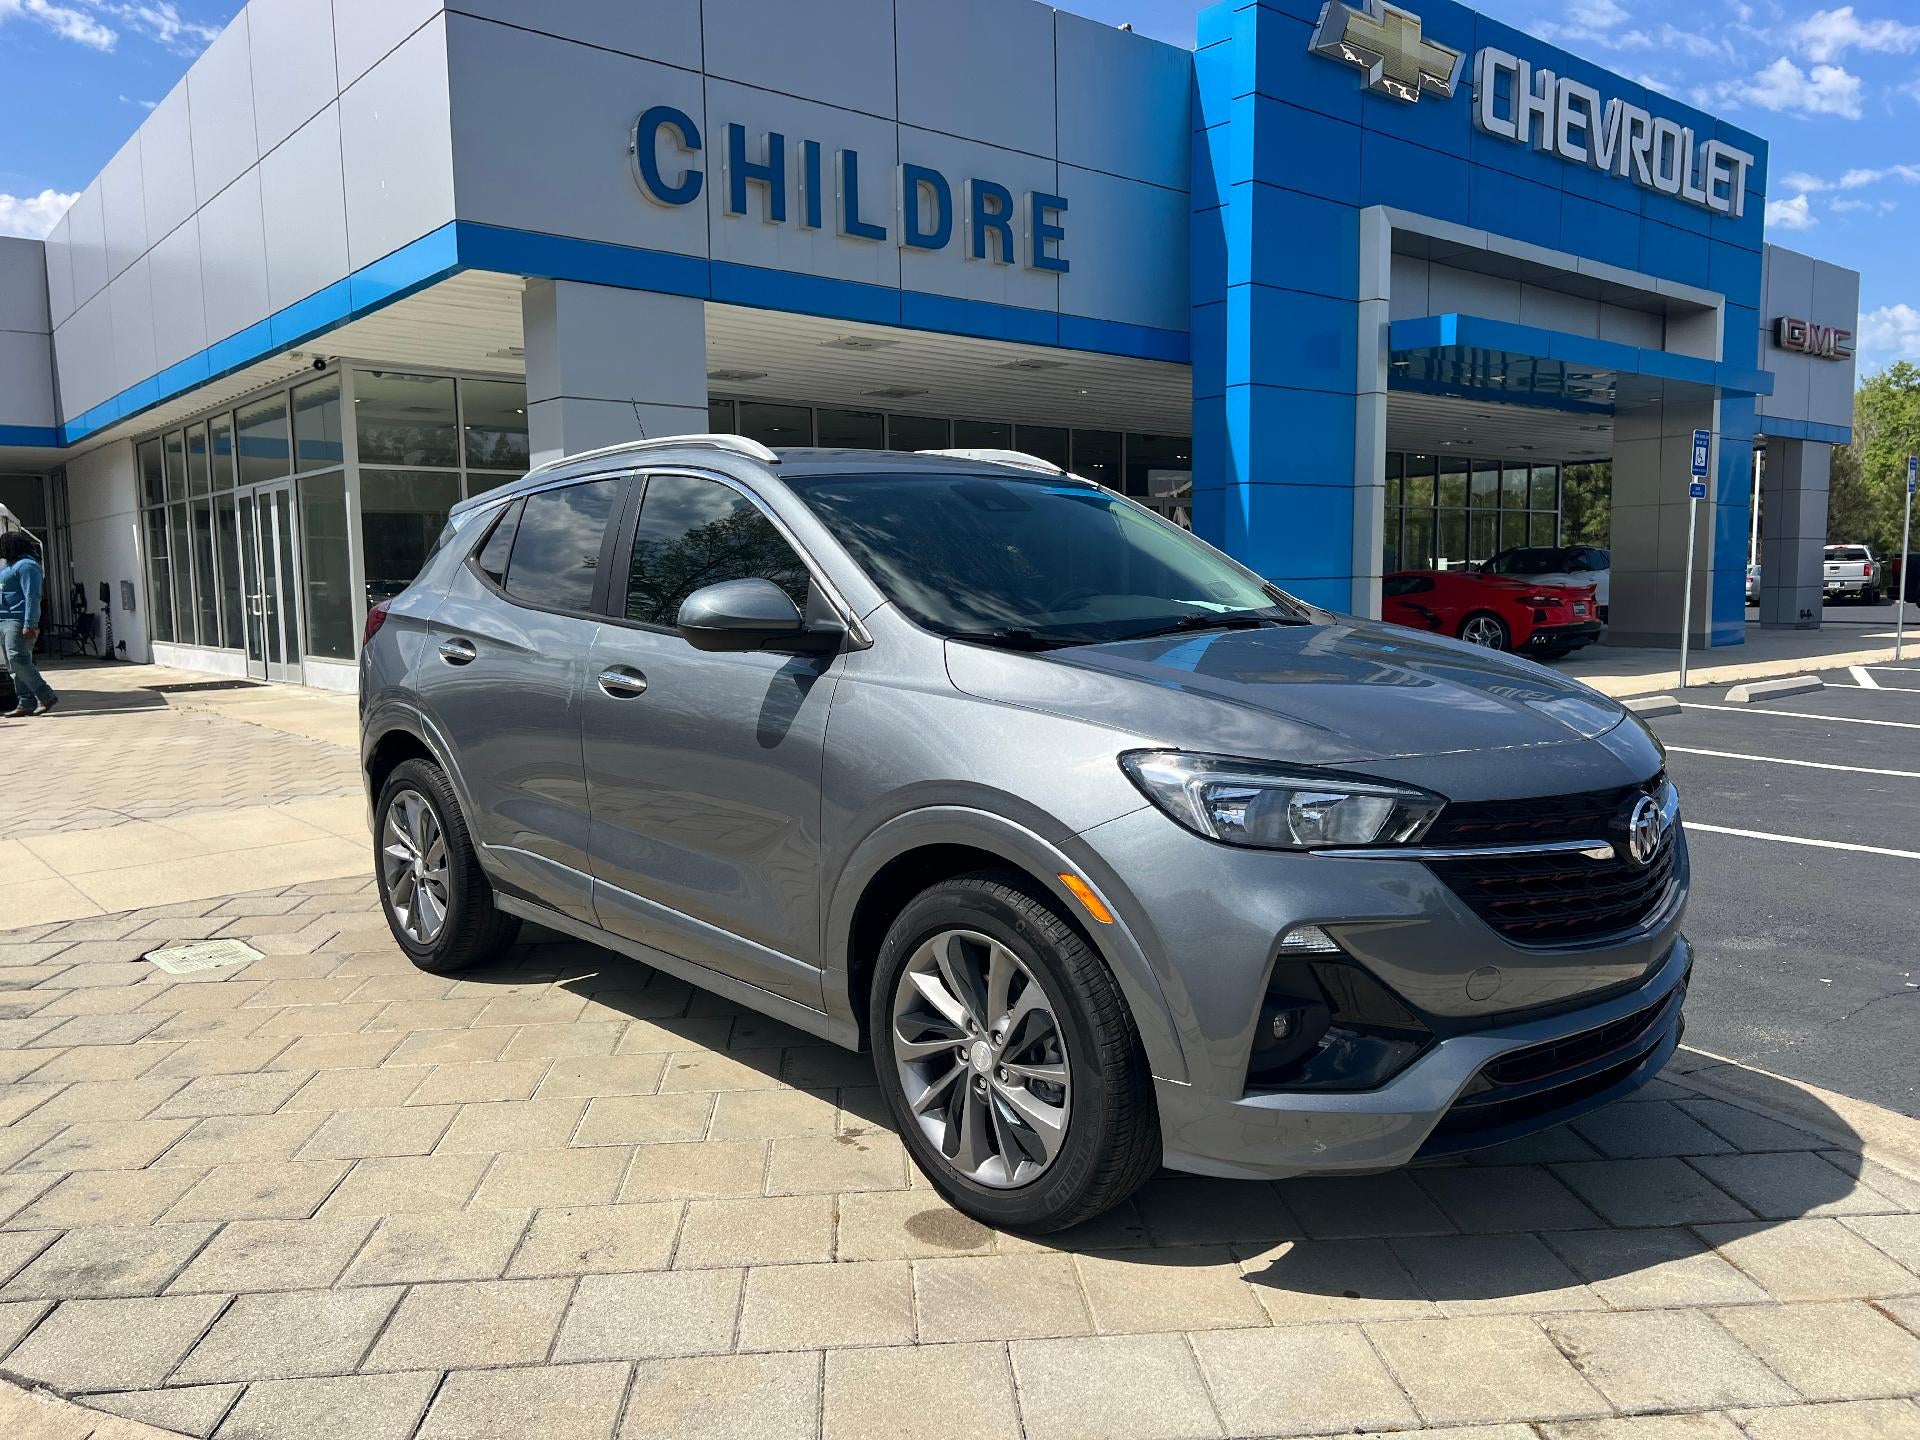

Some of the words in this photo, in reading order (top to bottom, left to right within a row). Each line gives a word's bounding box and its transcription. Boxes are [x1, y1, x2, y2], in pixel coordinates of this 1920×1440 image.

[631, 106, 1070, 273] CHILDRE
[1474, 46, 1755, 217] CHEVROLET
[1778, 317, 1851, 360] GMC
